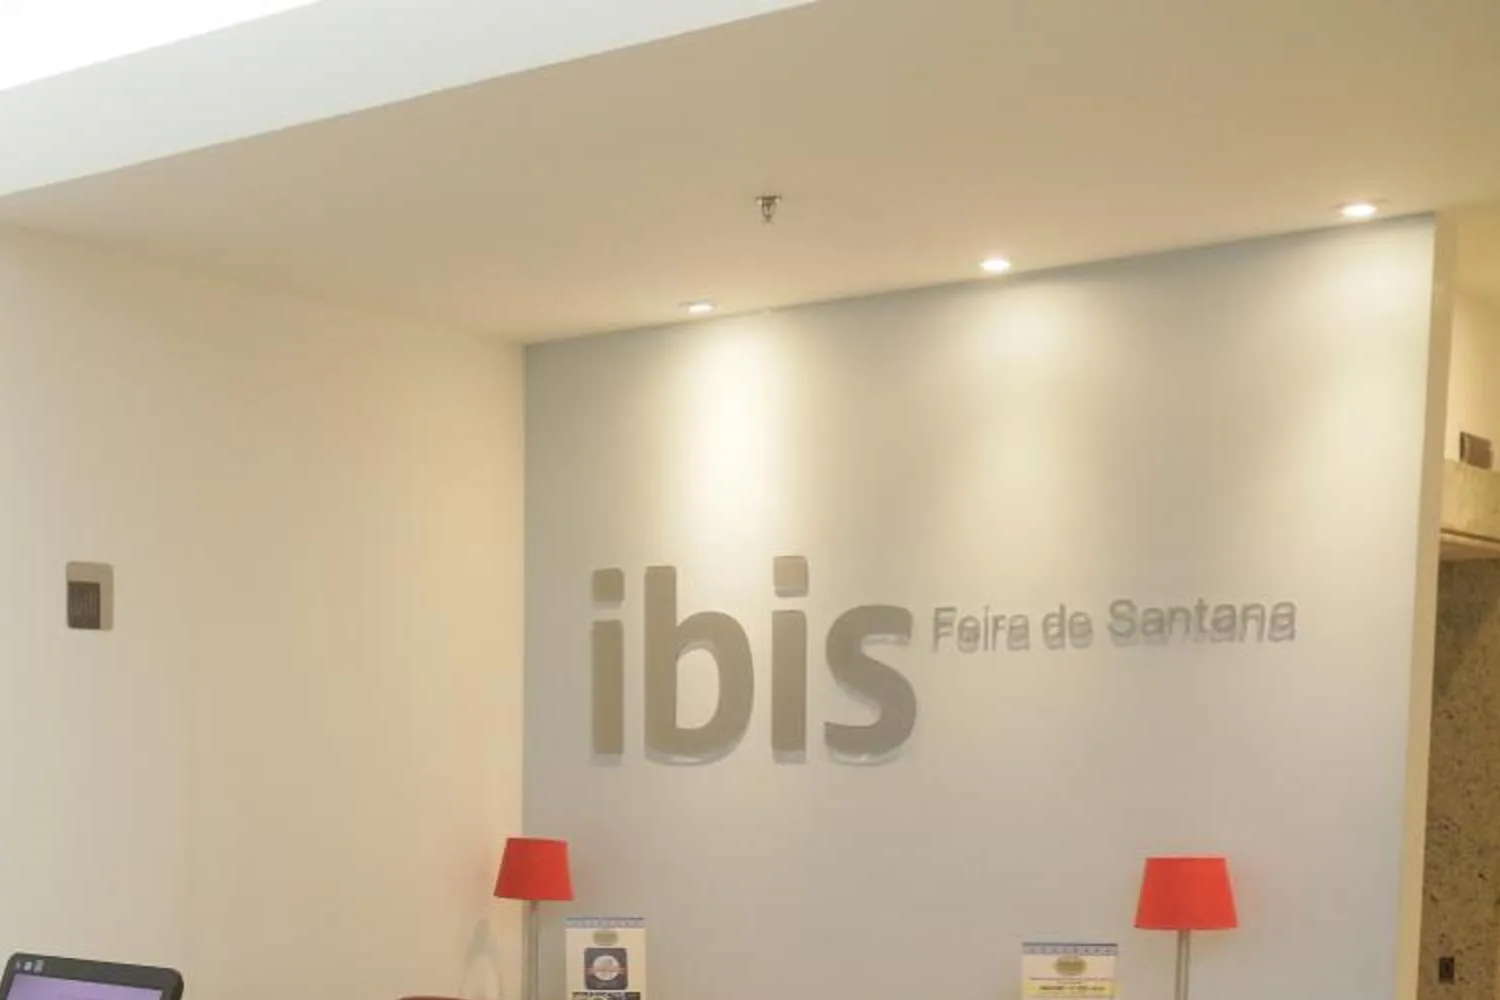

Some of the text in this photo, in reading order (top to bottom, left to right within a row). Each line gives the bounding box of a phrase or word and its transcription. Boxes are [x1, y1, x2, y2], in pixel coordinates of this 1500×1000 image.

[591, 555, 918, 764] ibis
[933, 598, 1297, 652] Feira de Santana
